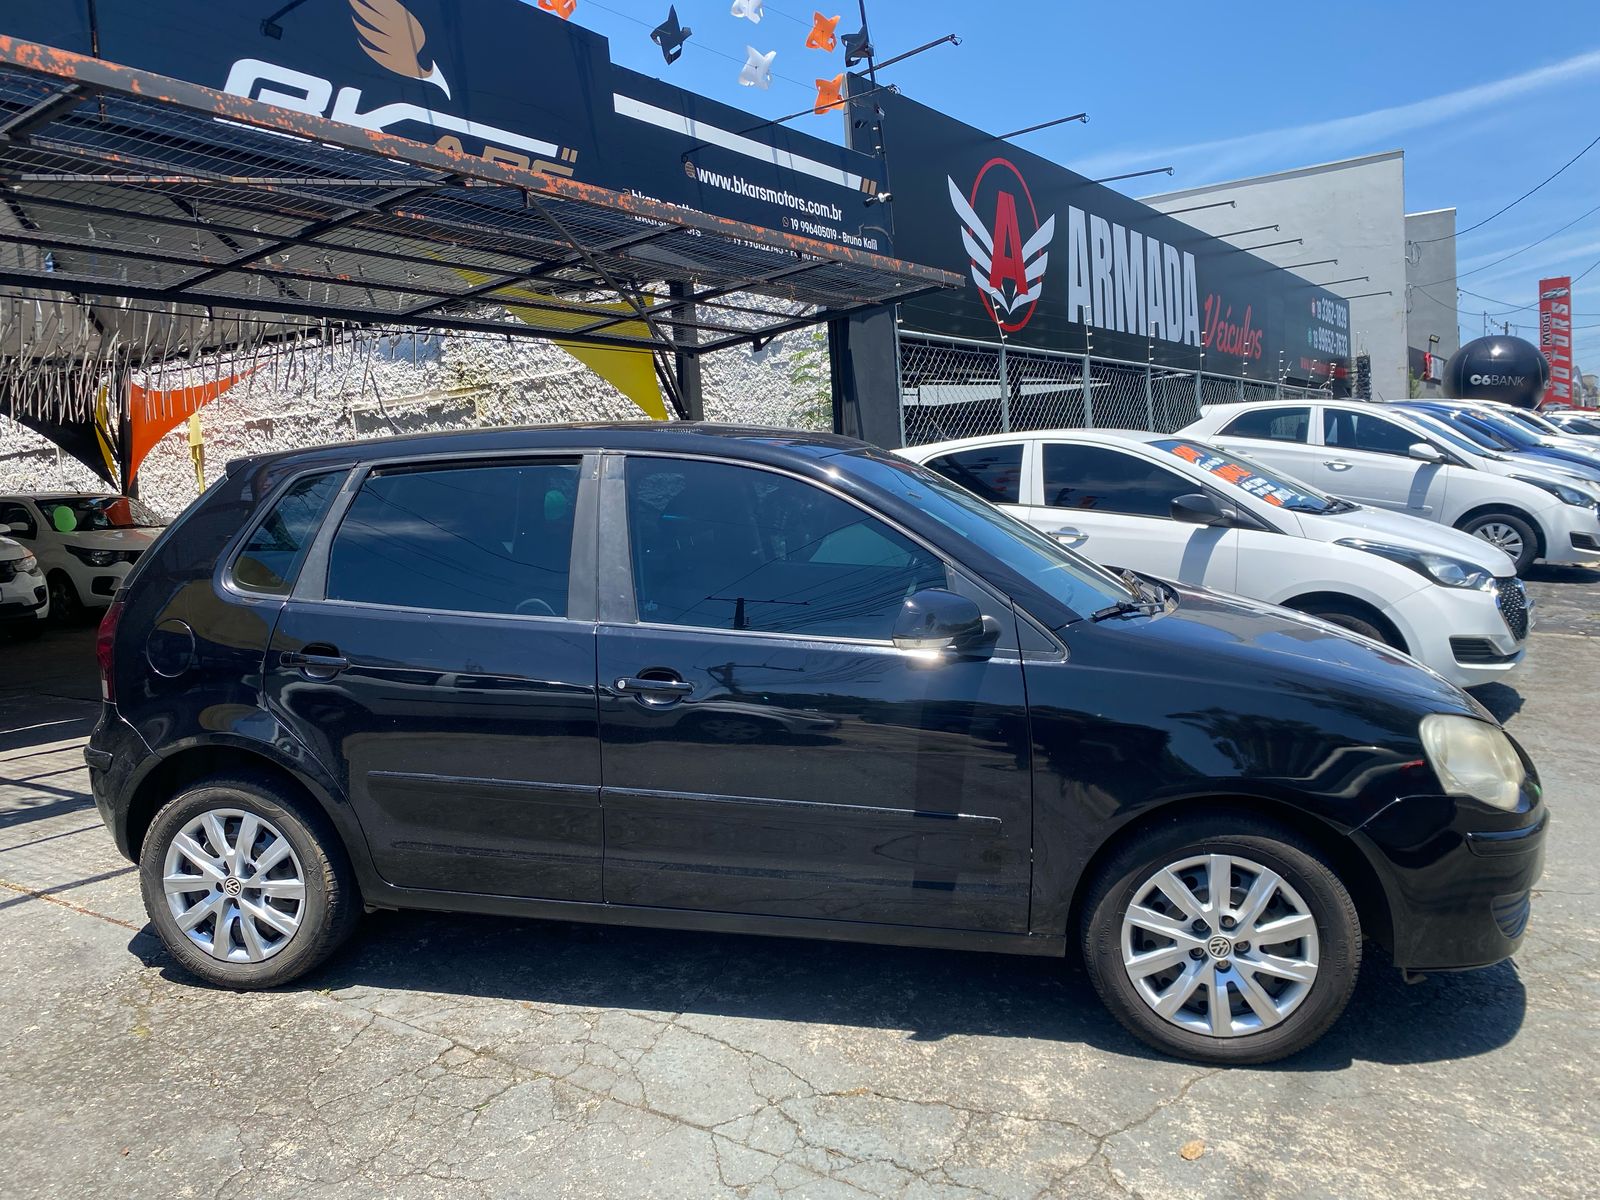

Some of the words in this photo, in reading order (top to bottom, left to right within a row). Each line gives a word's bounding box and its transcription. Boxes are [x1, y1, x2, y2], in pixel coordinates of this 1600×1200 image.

[696, 167, 842, 221] www.bkarsmotors.com.br
[790, 218, 799, 230] 19
[800, 220, 837, 240] 996405019
[842, 231, 862, 247] Bruno
[1067, 205, 1200, 347] ARMADA
[1542, 311, 1553, 346] MOGI
[1552, 303, 1570, 398] MOTORS
